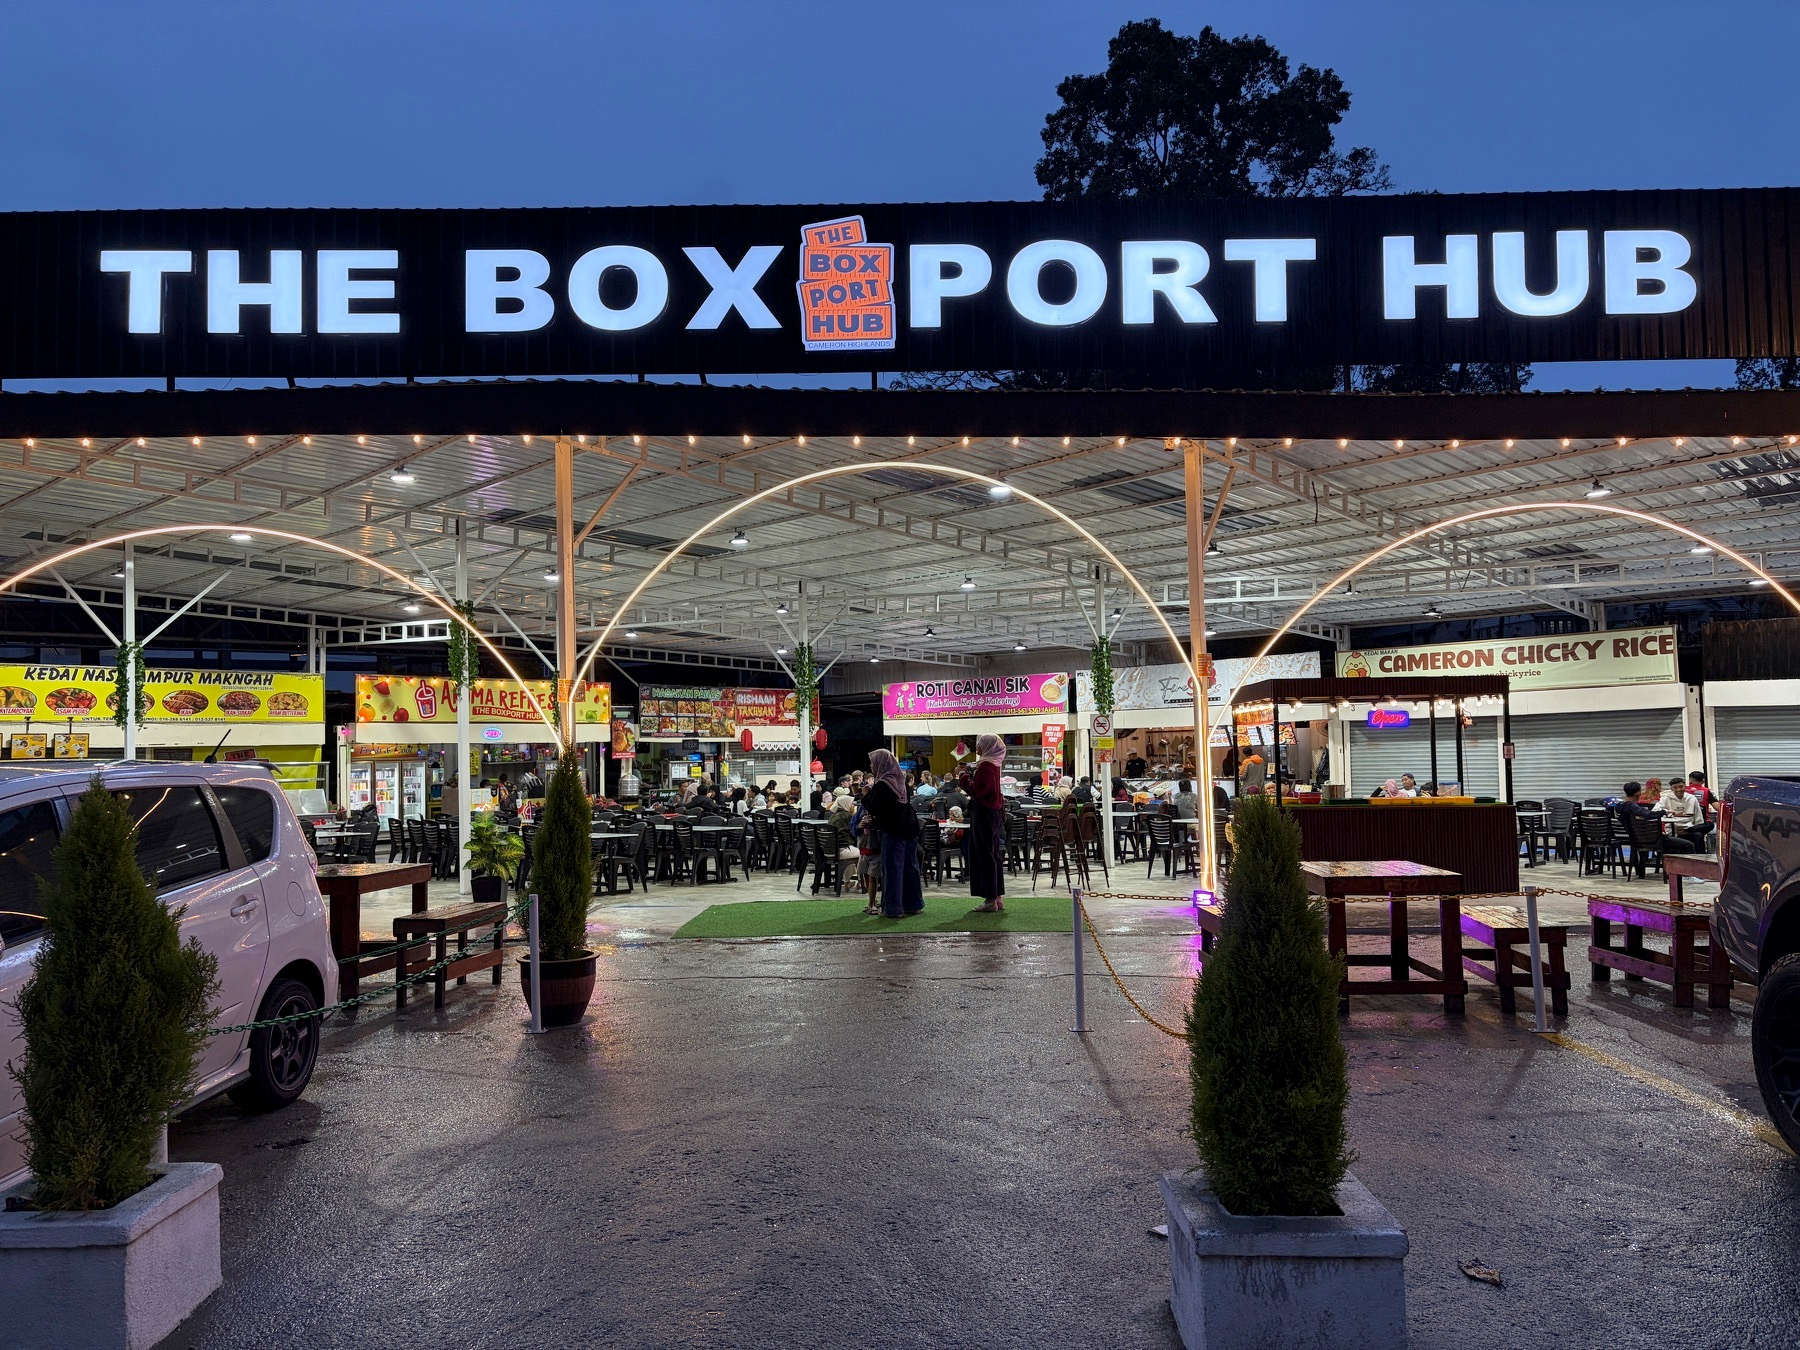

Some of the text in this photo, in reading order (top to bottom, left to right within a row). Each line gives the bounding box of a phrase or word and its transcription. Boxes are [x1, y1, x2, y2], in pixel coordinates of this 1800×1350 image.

[814, 226, 853, 244] THE
[810, 254, 882, 273] BOX
[101, 230, 1698, 334] THE BOX PORT HUB
[810, 280, 879, 308] PORT
[812, 314, 884, 333] HUB
[1379, 634, 1674, 673] CAMERON CHICKY RICE
[24, 667, 78, 682] KEDAI
[82, 668, 119, 683] NAS
[198, 672, 275, 686] MAKNGAH
[652, 687, 693, 698] MASAKAN
[694, 689, 722, 699] PANAS
[916, 676, 1031, 698] ROTI CANAI SIK
[474, 707, 489, 715] THE
[491, 708, 526, 719] BOXPORT
[1350, 704, 1356, 712] 3
[1371, 709, 1407, 729] Open
[485, 730, 501, 738] OPEN
